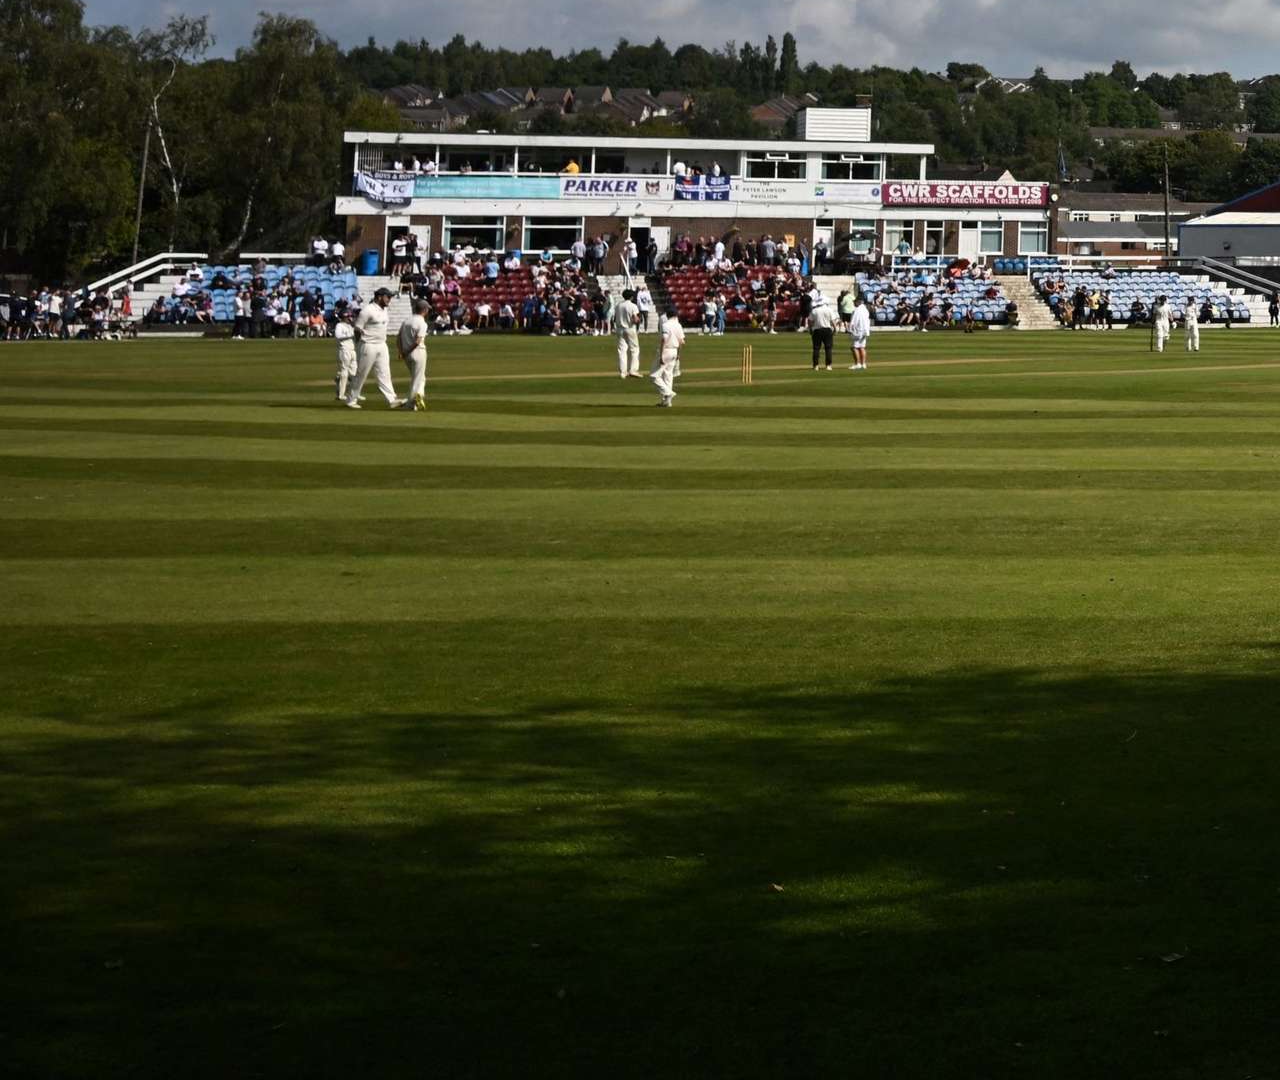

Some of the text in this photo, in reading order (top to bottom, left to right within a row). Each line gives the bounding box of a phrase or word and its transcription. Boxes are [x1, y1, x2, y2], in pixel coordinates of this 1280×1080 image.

[393, 184, 406, 193] FC
[563, 180, 638, 193] PARKER
[889, 184, 1042, 199] CWR SCAFFOLDS
